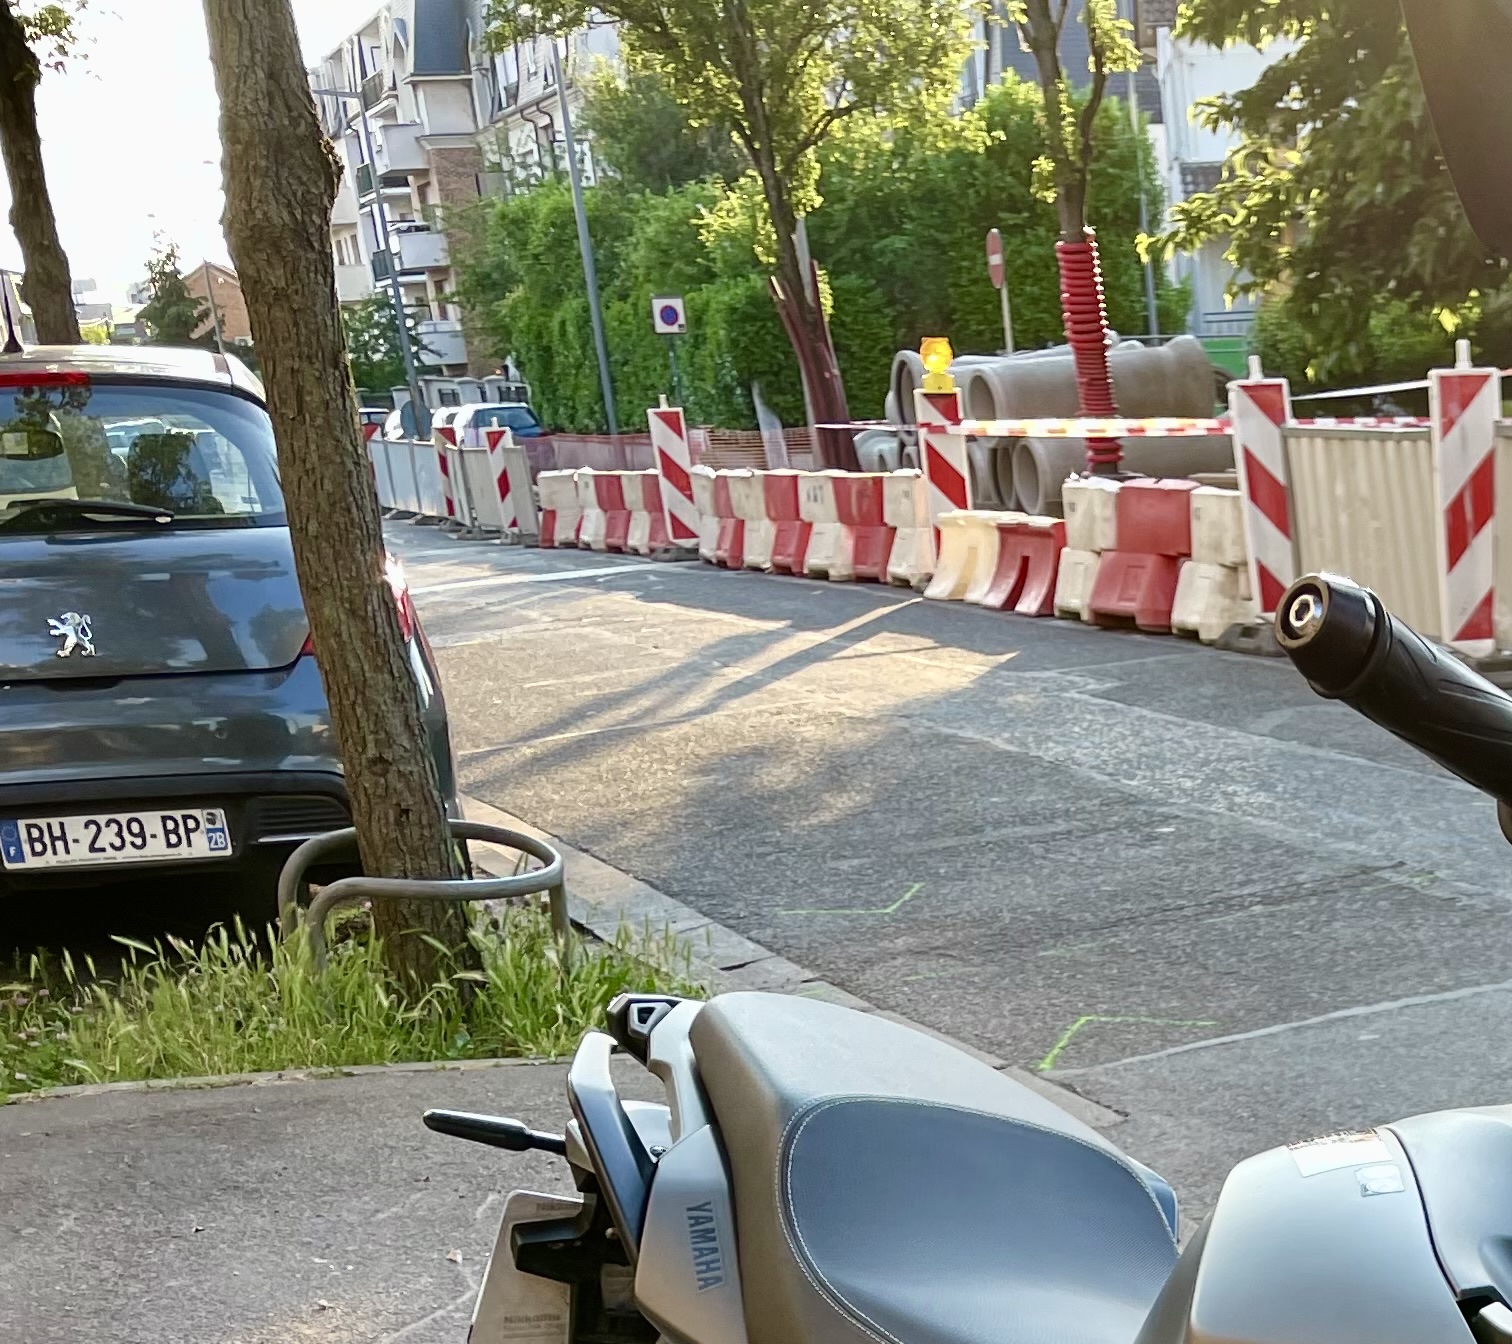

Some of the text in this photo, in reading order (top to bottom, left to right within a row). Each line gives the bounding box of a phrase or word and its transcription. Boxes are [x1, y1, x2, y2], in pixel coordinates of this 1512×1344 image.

[9, 814, 201, 858] F BH-239-BP
[208, 832, 226, 850] 2B
[685, 1201, 724, 1292] YAMAHA
